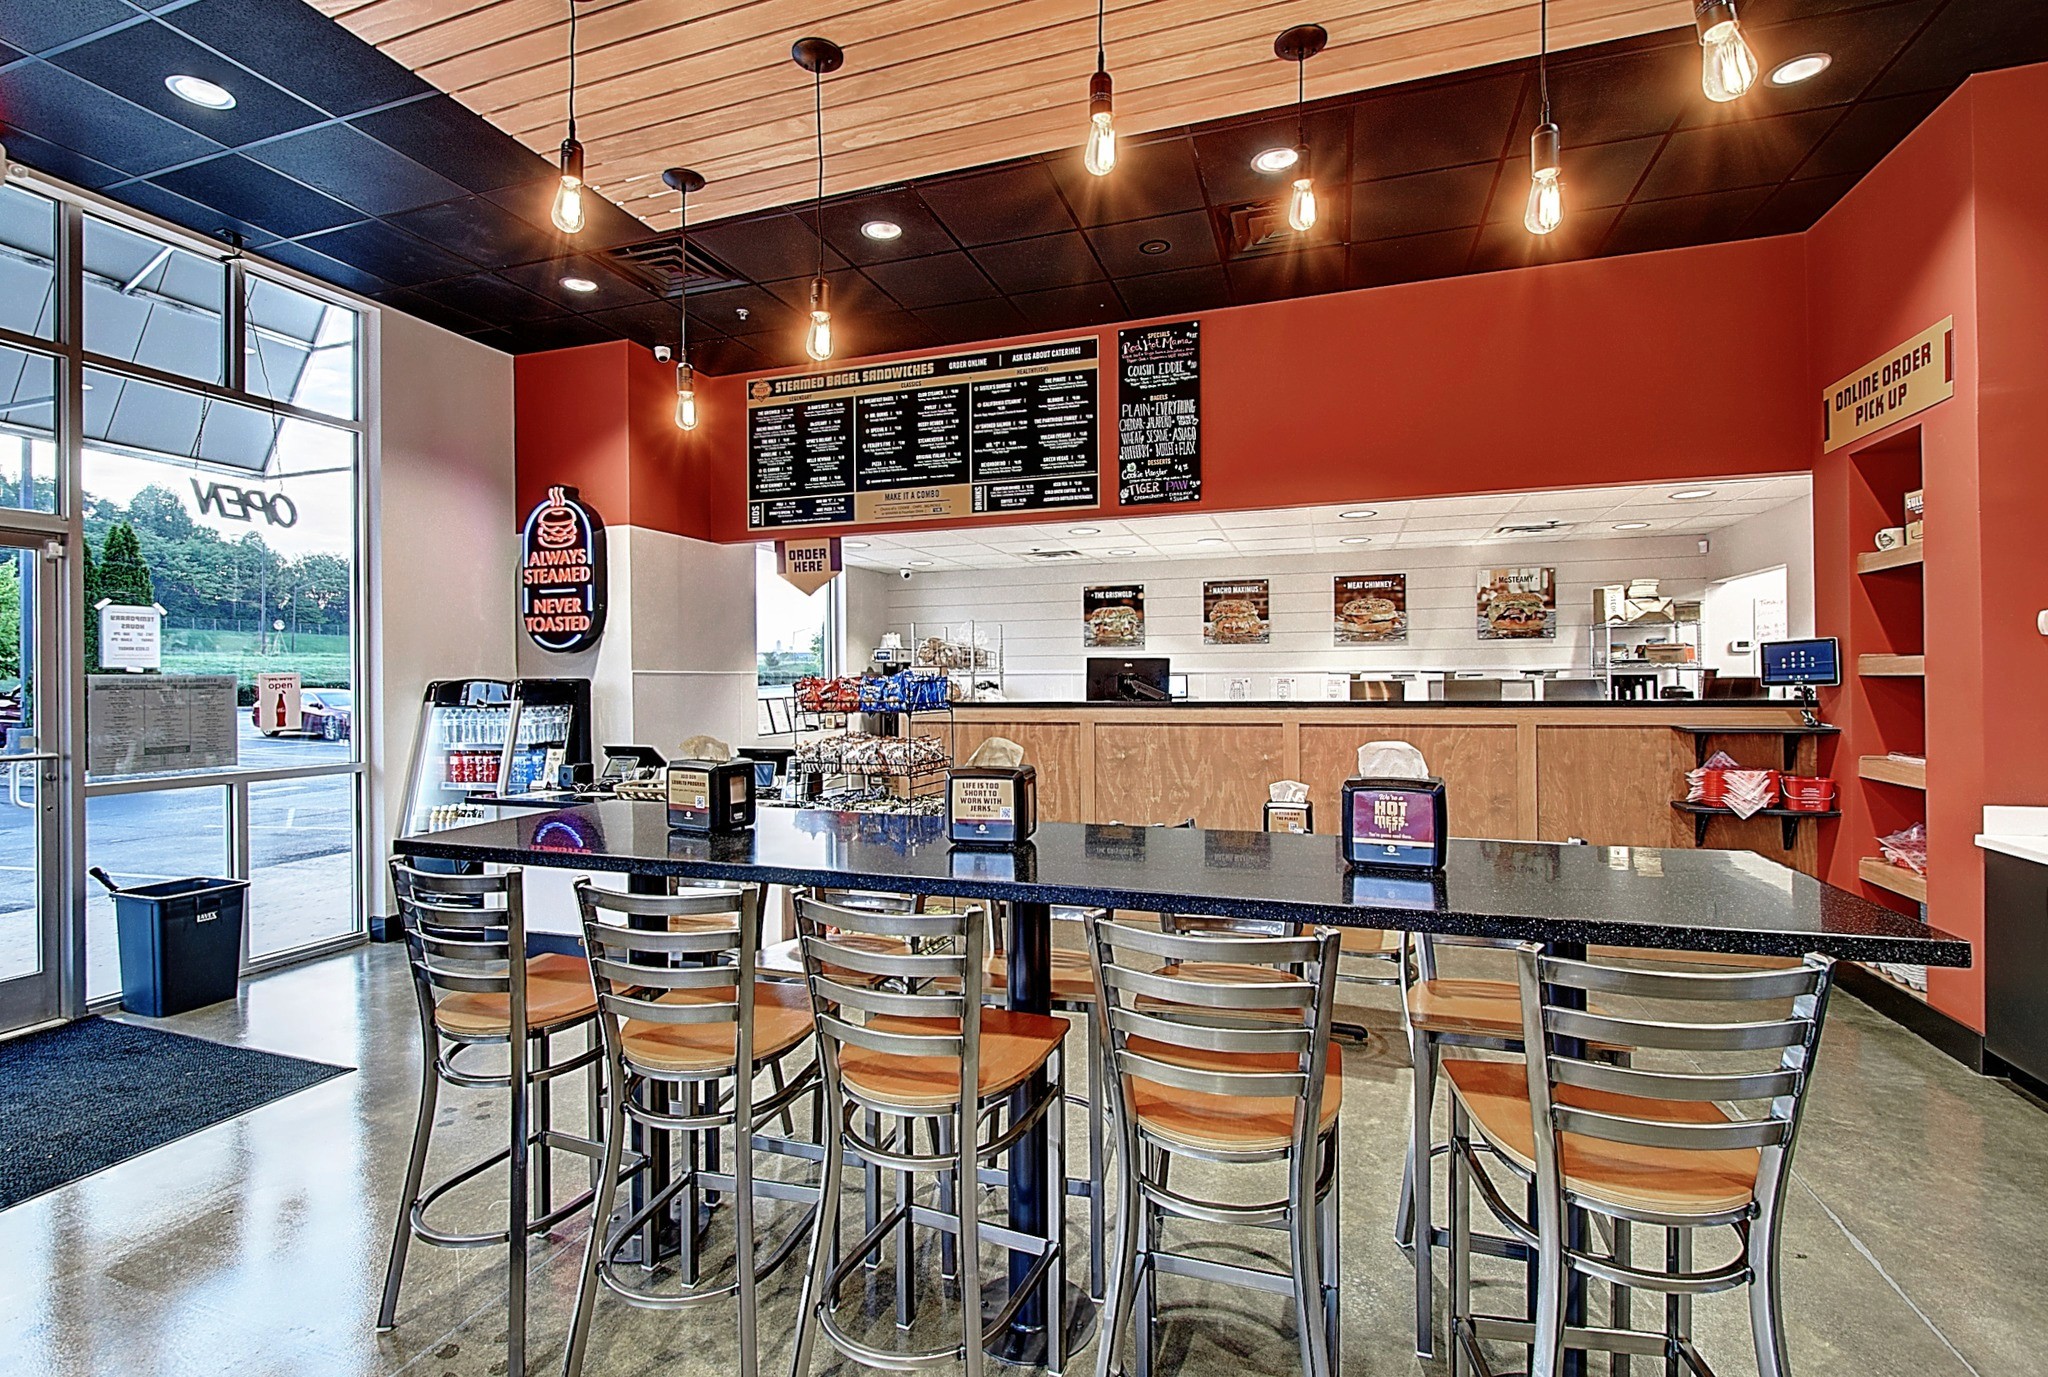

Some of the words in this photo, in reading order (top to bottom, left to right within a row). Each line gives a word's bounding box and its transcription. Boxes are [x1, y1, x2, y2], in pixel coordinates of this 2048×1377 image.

[1148, 331, 1170, 339] SPECIALS
[1162, 336, 1192, 350] Mama
[1012, 353, 1023, 362] ASK
[1024, 352, 1032, 361] US
[1032, 350, 1050, 360] ABOUT
[1052, 346, 1081, 358] CATERING!
[949, 359, 967, 370] ORDER
[968, 358, 987, 368] ONLINE
[1128, 364, 1155, 377] COUSIN
[1158, 361, 1185, 374] EDDIE
[775, 377, 825, 393] STEAMED
[826, 372, 860, 387] BAGEL
[862, 362, 934, 382] SANDWICHES
[1836, 370, 1878, 412] ONLINE
[1882, 342, 1931, 387] ORDER
[1122, 403, 1150, 417] PLAIN
[1156, 399, 1196, 415] EVERYTHING
[1856, 394, 1884, 426] PICK
[1888, 383, 1907, 410] UP
[1172, 426, 1196, 442] ASIAGO
[1179, 441, 1195, 455] FLAX
[885, 493, 901, 501] MAKE
[916, 490, 940, 498] COMBO
[1127, 482, 1159, 496] TIGER
[1166, 480, 1188, 491] PAW
[752, 505, 760, 524] KIDS
[529, 548, 586, 566] ALWAYS
[789, 548, 826, 560] ORDER
[794, 561, 822, 572] HERE
[524, 566, 590, 584] STEAMED
[534, 598, 582, 614] NEVER
[525, 615, 590, 632] TOASTED
[1374, 800, 1408, 816] HOT
